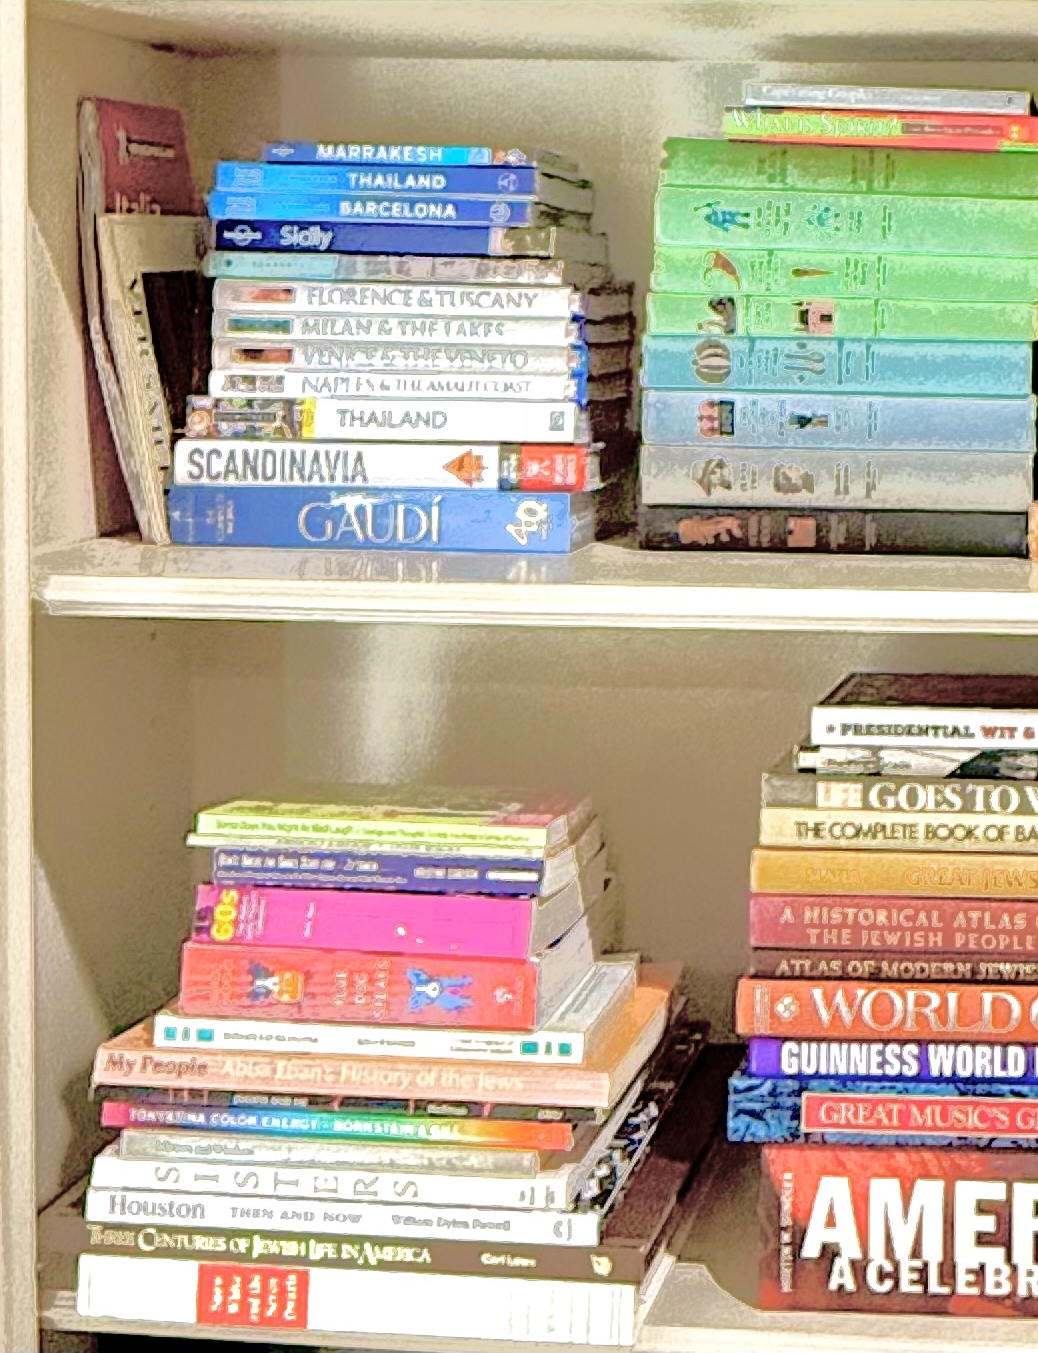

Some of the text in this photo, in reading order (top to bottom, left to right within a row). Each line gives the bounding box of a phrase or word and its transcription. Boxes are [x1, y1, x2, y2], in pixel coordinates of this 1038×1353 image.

[316, 145, 443, 162] MARRAKESH
[348, 174, 446, 190] THAILAND
[340, 201, 456, 219] BARCELONA
[307, 288, 414, 306] FLORENCE
[436, 291, 539, 309] TUSCANY
[337, 409, 447, 429] THAILAND
[187, 448, 369, 484] SCANDINAVIA
[840, 722, 975, 737] PRESIDENTIAL
[980, 725, 1016, 739] WIT
[870, 783, 962, 809] GOES
[968, 785, 1018, 812] TO
[795, 821, 825, 839] THE
[827, 821, 916, 841] COMPLETE
[925, 823, 975, 841] BOOK
[979, 824, 1009, 842] OF
[904, 870, 977, 887] GREAT
[779, 908, 793, 923] A
[803, 908, 943, 928] HISTORICAL
[954, 910, 1028, 929] ATLAS
[807, 929, 1036, 951] THE JEWISH PEOPLE
[776, 960, 841, 975] ATLAS
[849, 961, 875, 976] OF
[882, 962, 973, 978] MODERN
[811, 989, 1022, 1032] WORLD
[781, 1044, 919, 1076] GUINNESS
[928, 1045, 1026, 1077] WORLD
[820, 1101, 902, 1127] GREAT
[910, 1105, 1009, 1130] MUSIC'S
[108, 1196, 205, 1219] Houston
[828, 1258, 856, 1291] A
